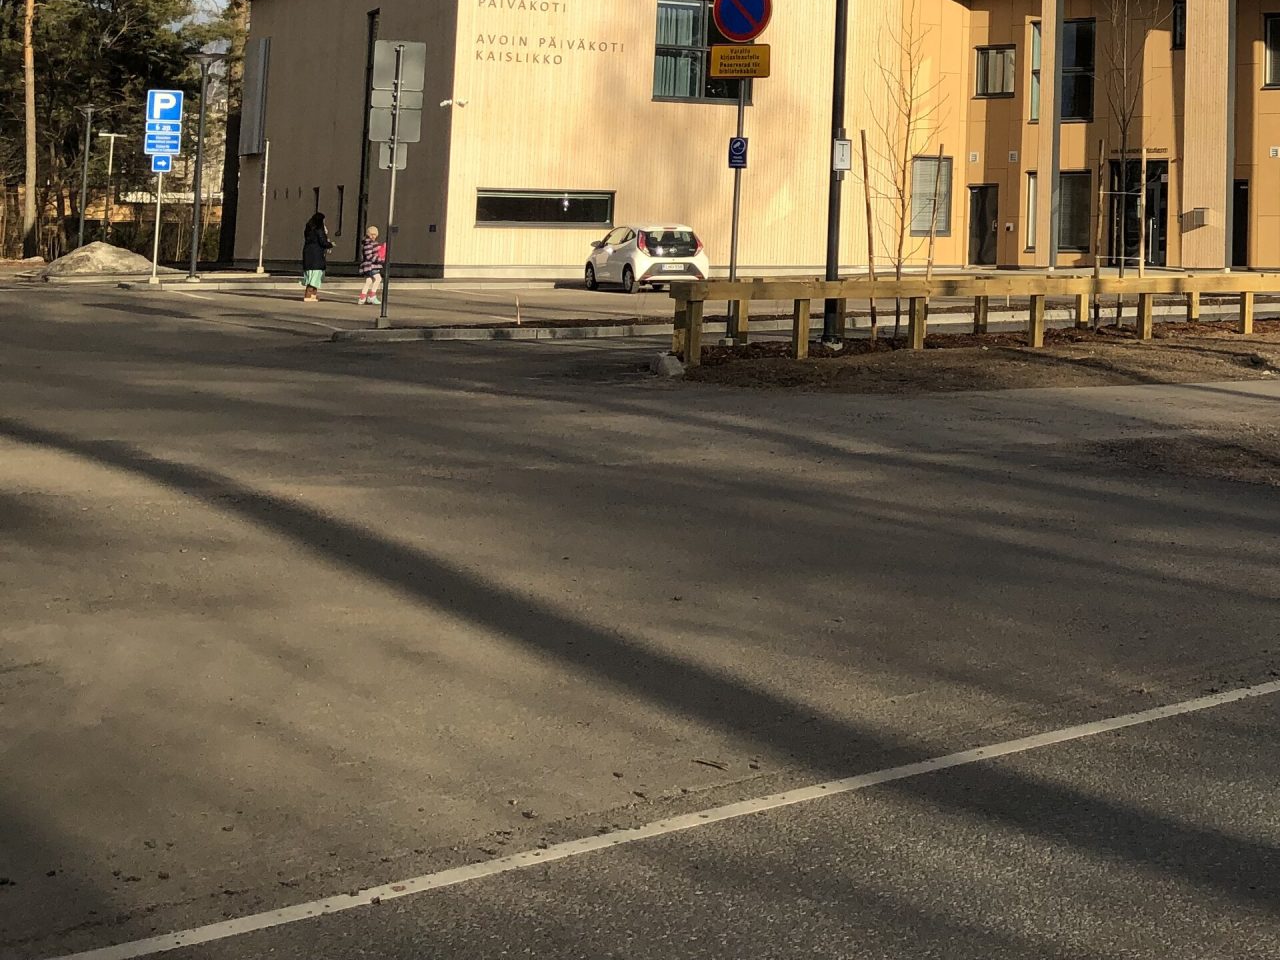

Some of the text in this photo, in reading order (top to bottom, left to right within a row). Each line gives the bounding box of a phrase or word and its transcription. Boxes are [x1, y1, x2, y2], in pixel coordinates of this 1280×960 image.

[476, 34, 624, 53] AVOIN PÄIVÄKOTI
[475, 50, 563, 65] KAISLIKKO
[154, 93, 176, 119] P
